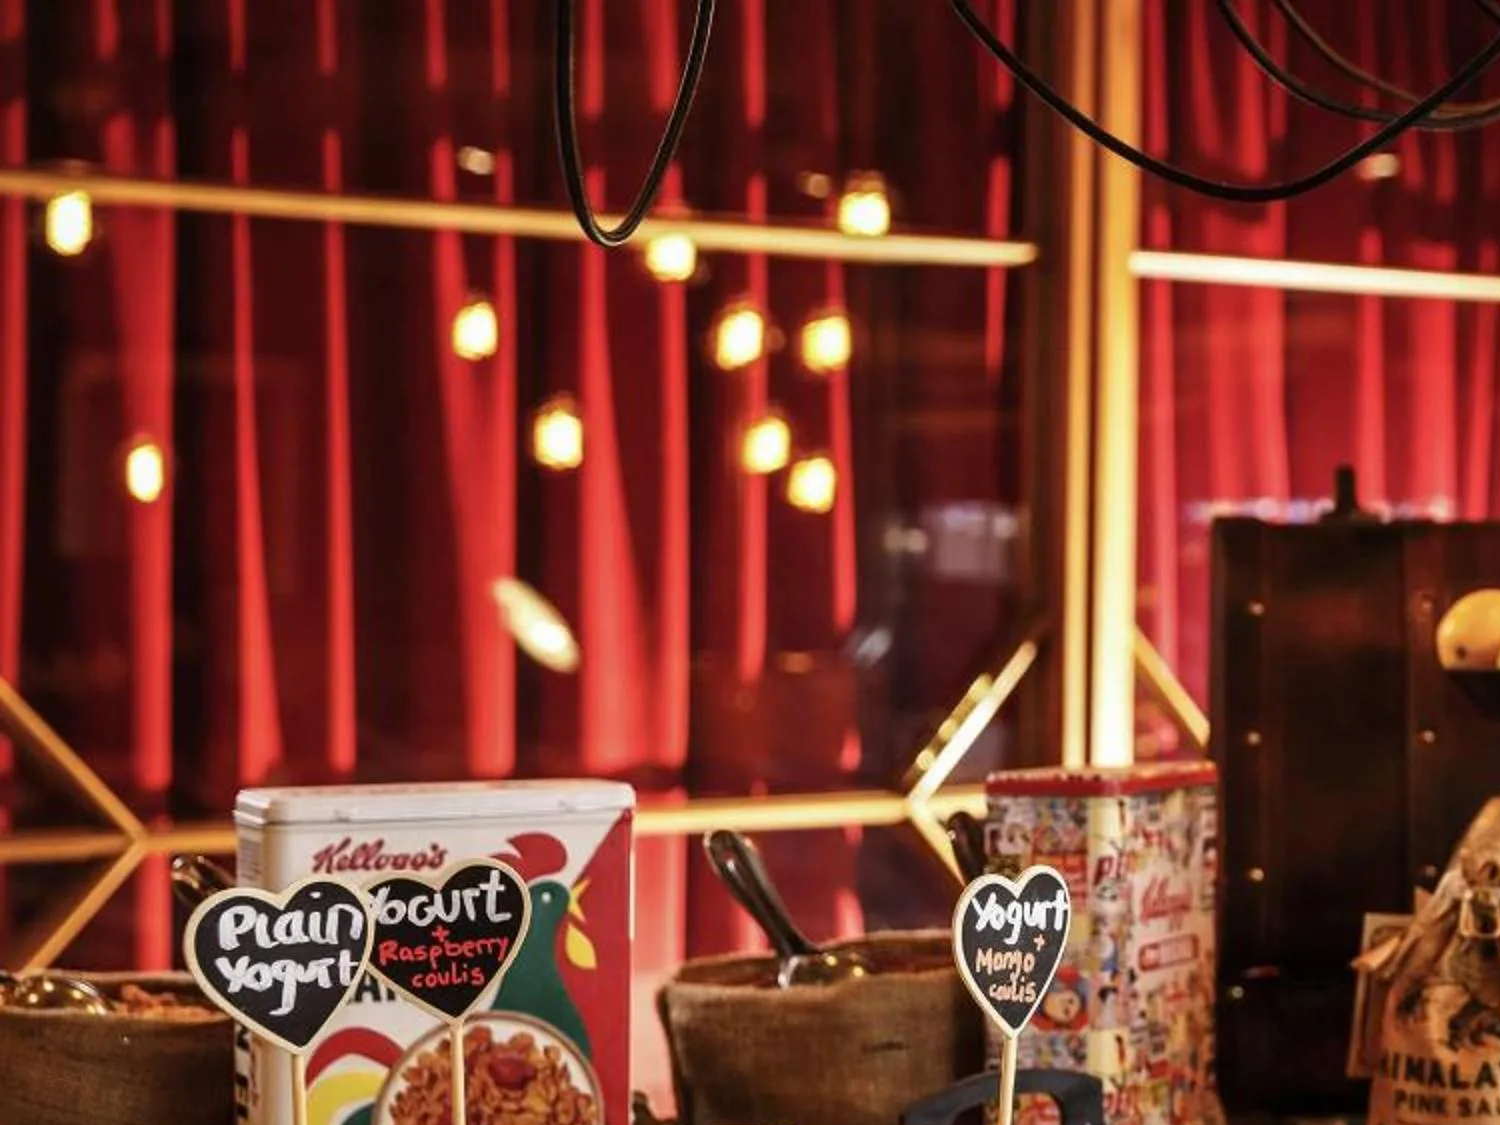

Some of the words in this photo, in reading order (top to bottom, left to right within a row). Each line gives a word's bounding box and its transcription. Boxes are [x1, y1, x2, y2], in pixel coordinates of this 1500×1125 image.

[219, 890, 363, 951] Plain
[971, 888, 1068, 945] Yogurt
[378, 937, 509, 970] Raspberry
[411, 961, 485, 988] coulis
[214, 949, 360, 1017] Yogurt
